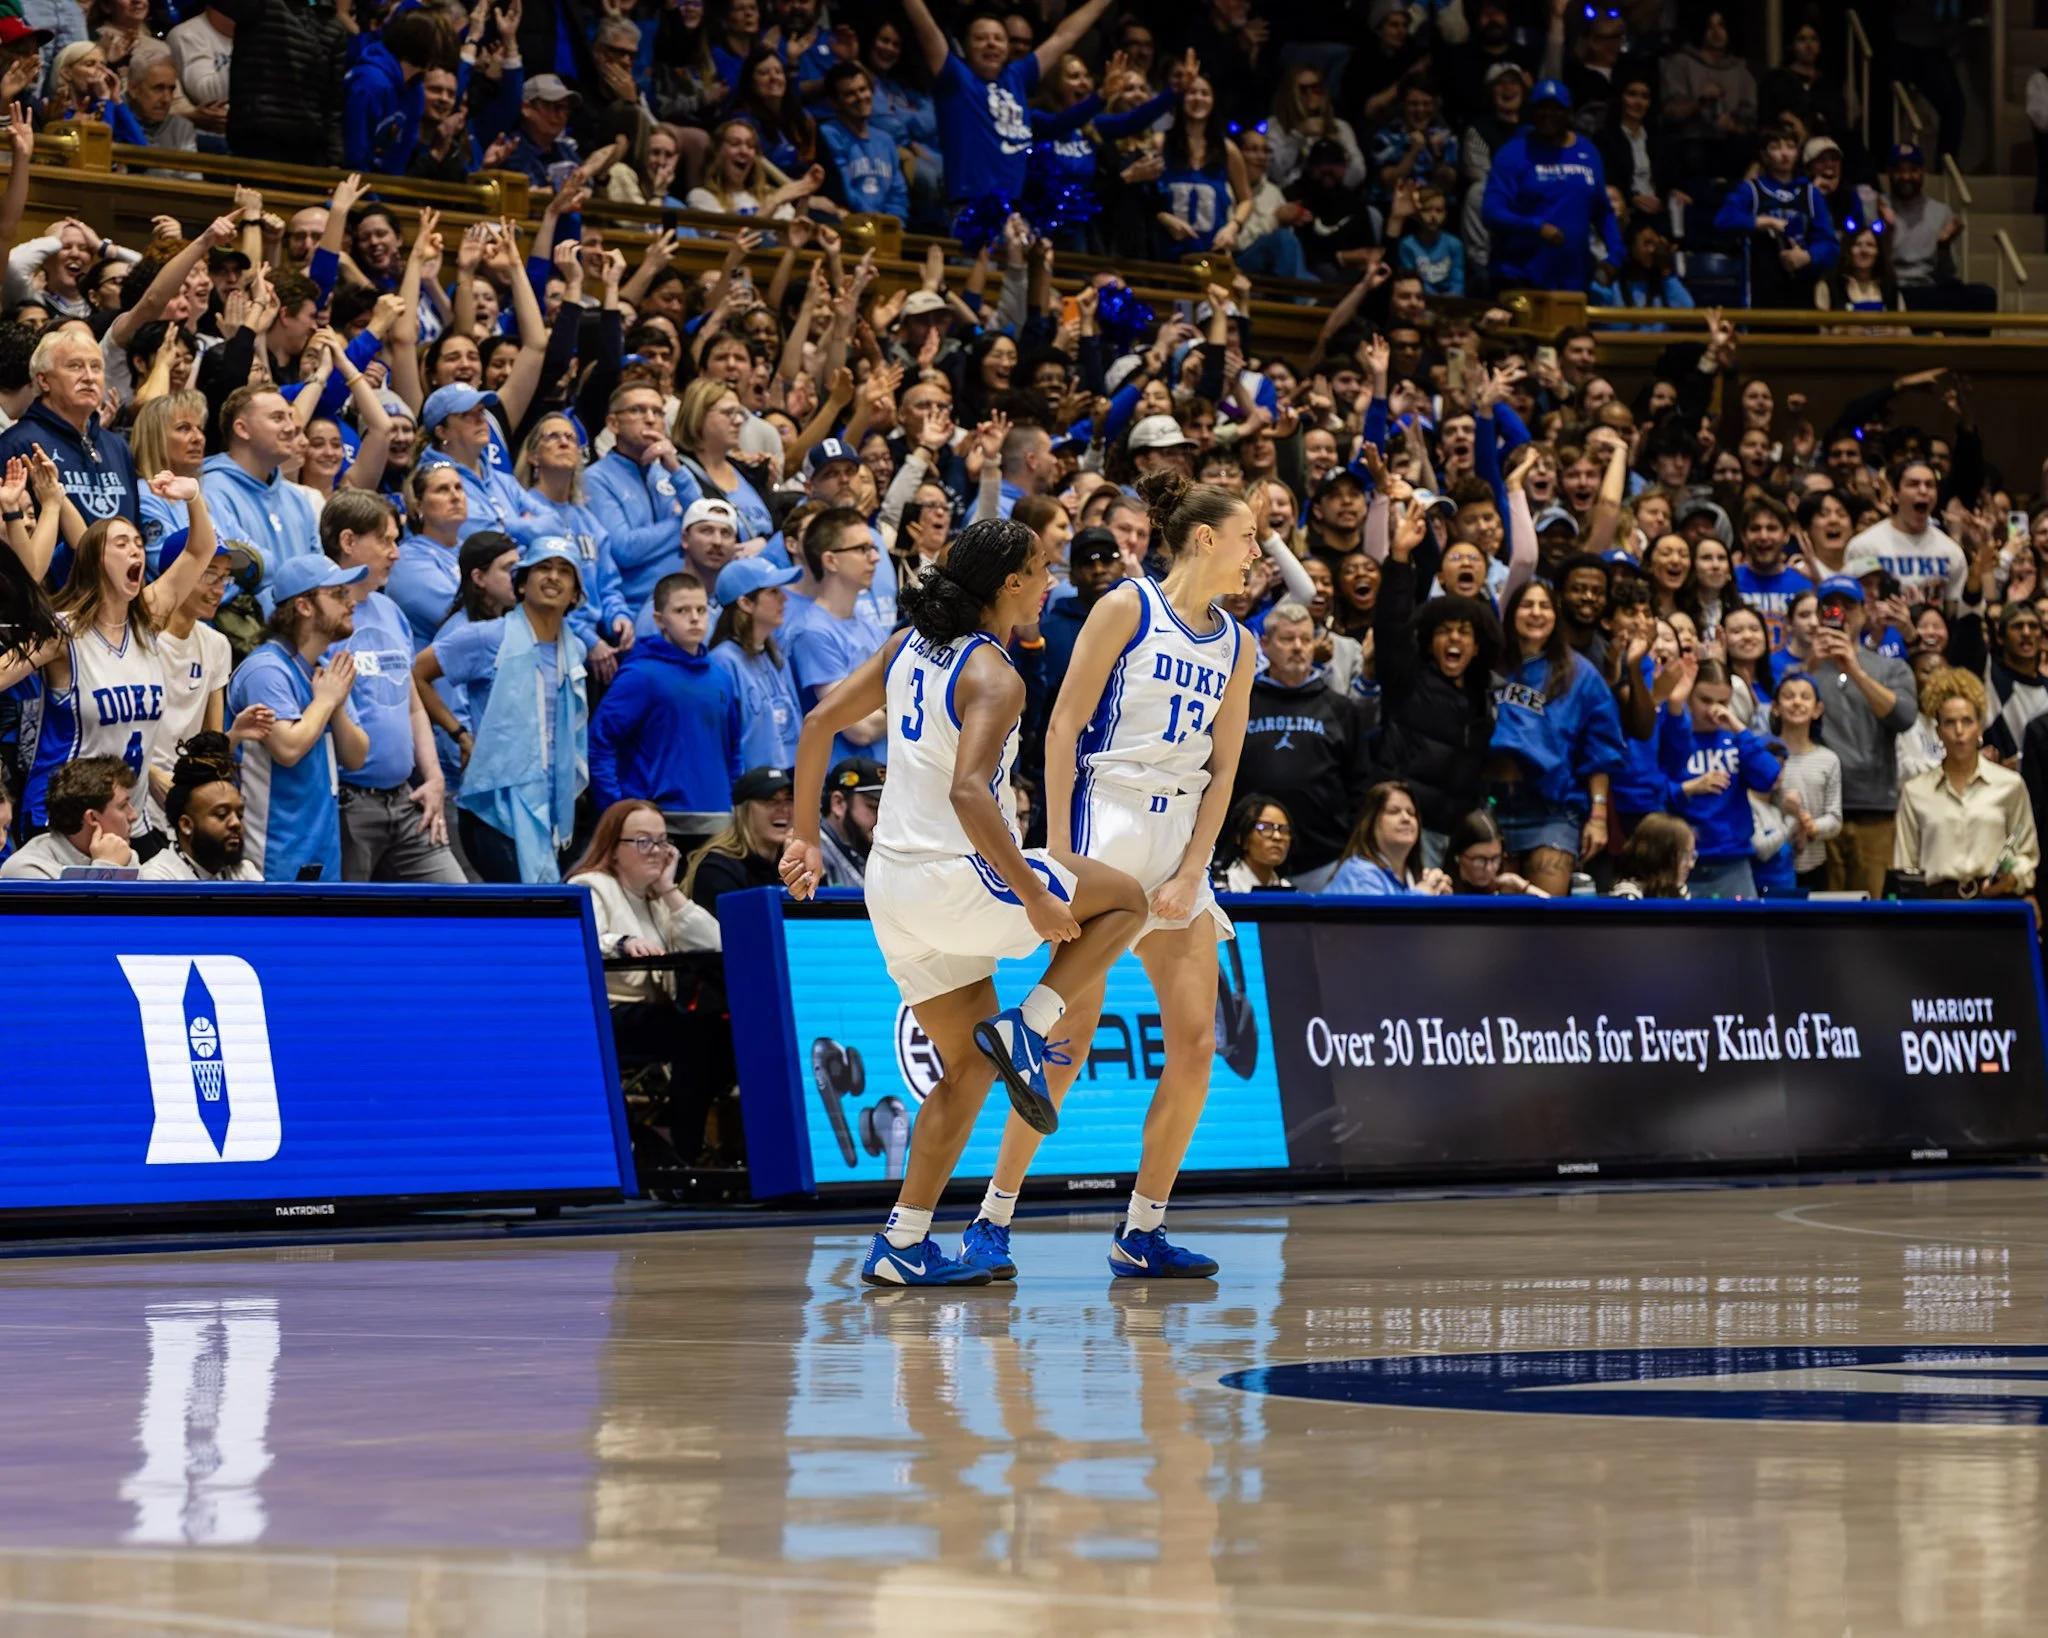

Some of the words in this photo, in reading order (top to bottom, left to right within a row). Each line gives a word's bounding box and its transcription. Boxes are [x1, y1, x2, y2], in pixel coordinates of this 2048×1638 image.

[95, 471, 121, 487] EEL
[1877, 555, 1951, 577] DUKE
[1153, 653, 1227, 701] DUKE
[92, 684, 163, 726] DUKE
[901, 668, 924, 742] 3
[1162, 694, 1204, 745] 13
[1246, 715, 1325, 736] CAROLINA
[122, 731, 144, 780] 4
[1686, 747, 1740, 775] UKE
[1149, 795, 1168, 813] D
[1911, 998, 1993, 1023] MARRIOTT
[1306, 1017, 1375, 1067] Over
[1380, 1018, 1414, 1067] 30
[1417, 1016, 1496, 1066] Hotel
[1497, 1015, 1593, 1065] Brands
[1595, 1014, 1633, 1063] for
[1635, 1015, 1709, 1073] Every
[1713, 1013, 1782, 1061] Kind
[1784, 1012, 1811, 1060] of
[1811, 1012, 1861, 1059] Fan
[1901, 1029, 2012, 1075] BONVOY
[275, 1204, 335, 1216] DAKTRONICS
